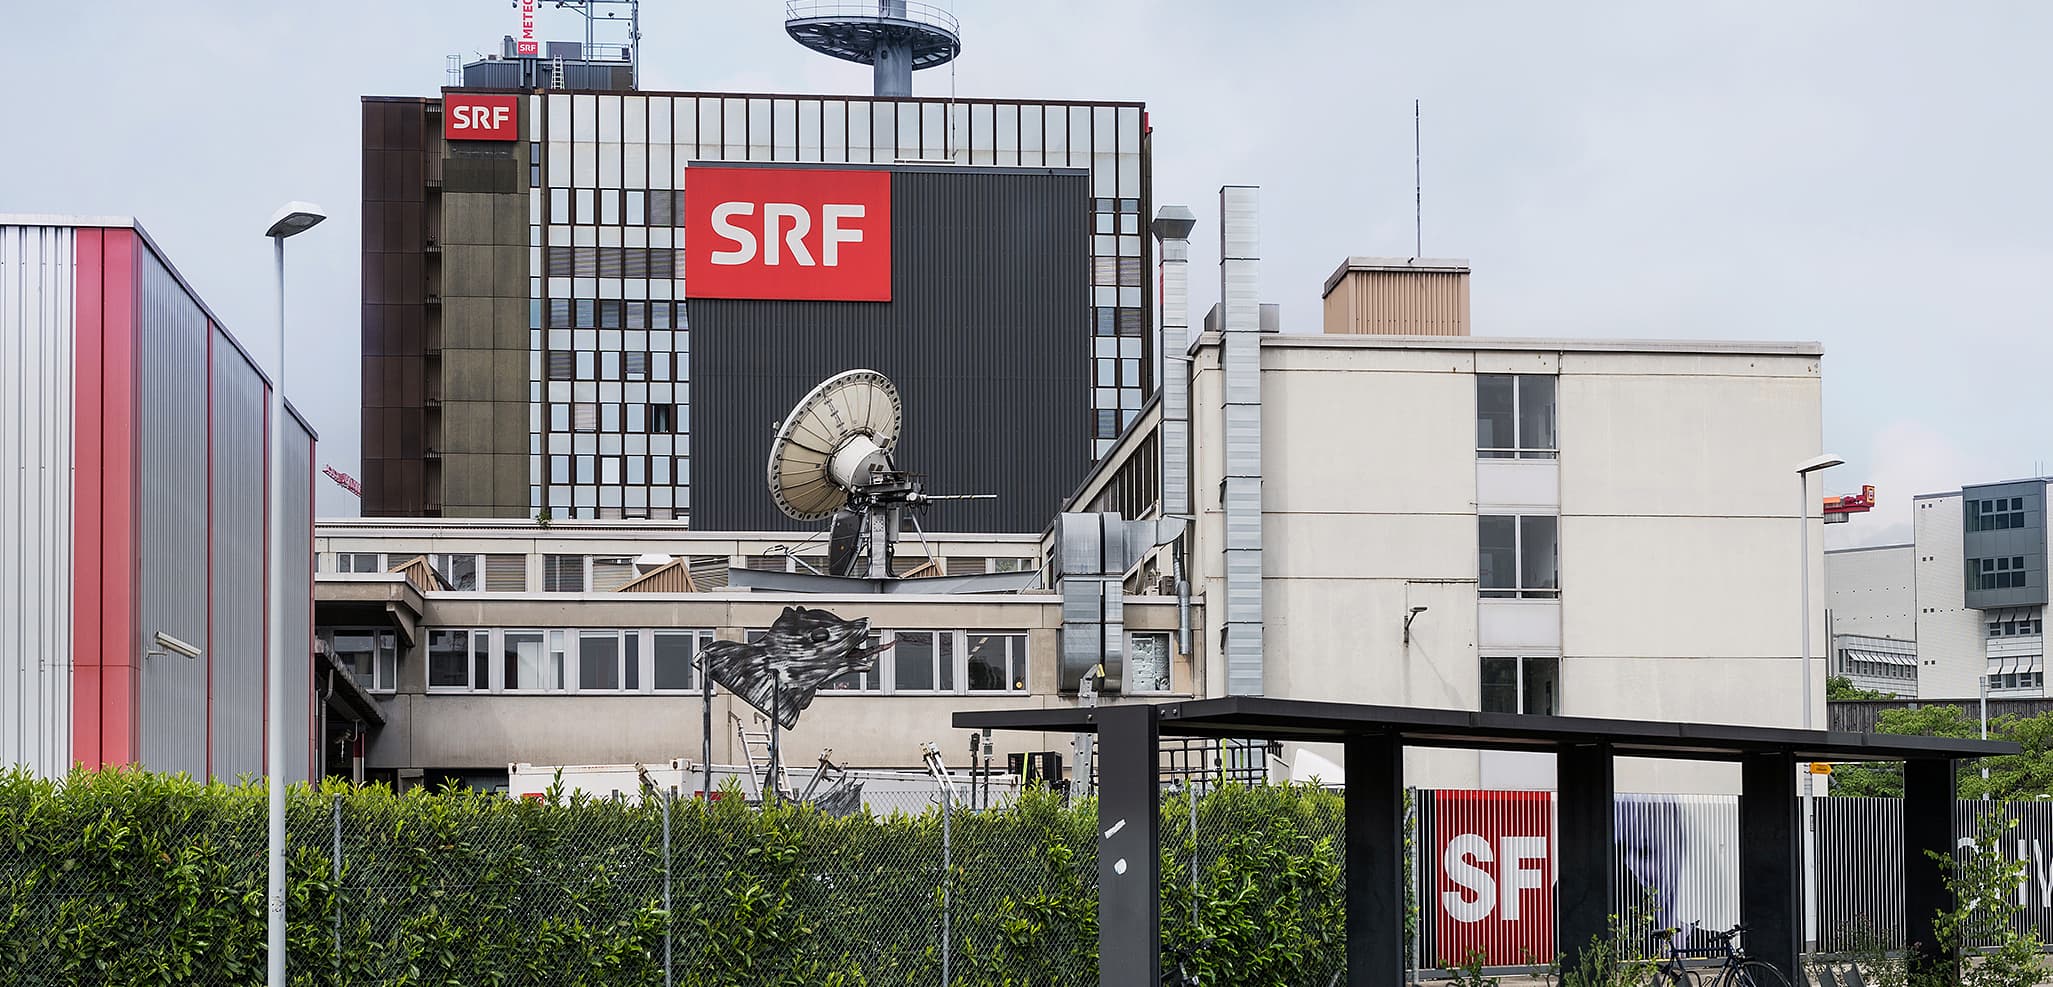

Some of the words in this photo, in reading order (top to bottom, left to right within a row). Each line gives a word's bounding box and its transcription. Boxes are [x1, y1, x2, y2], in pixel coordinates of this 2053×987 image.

[520, 44, 536, 52] SRF
[453, 105, 510, 130] SRF
[711, 201, 866, 267] SRF
[1442, 833, 1547, 924] SF
